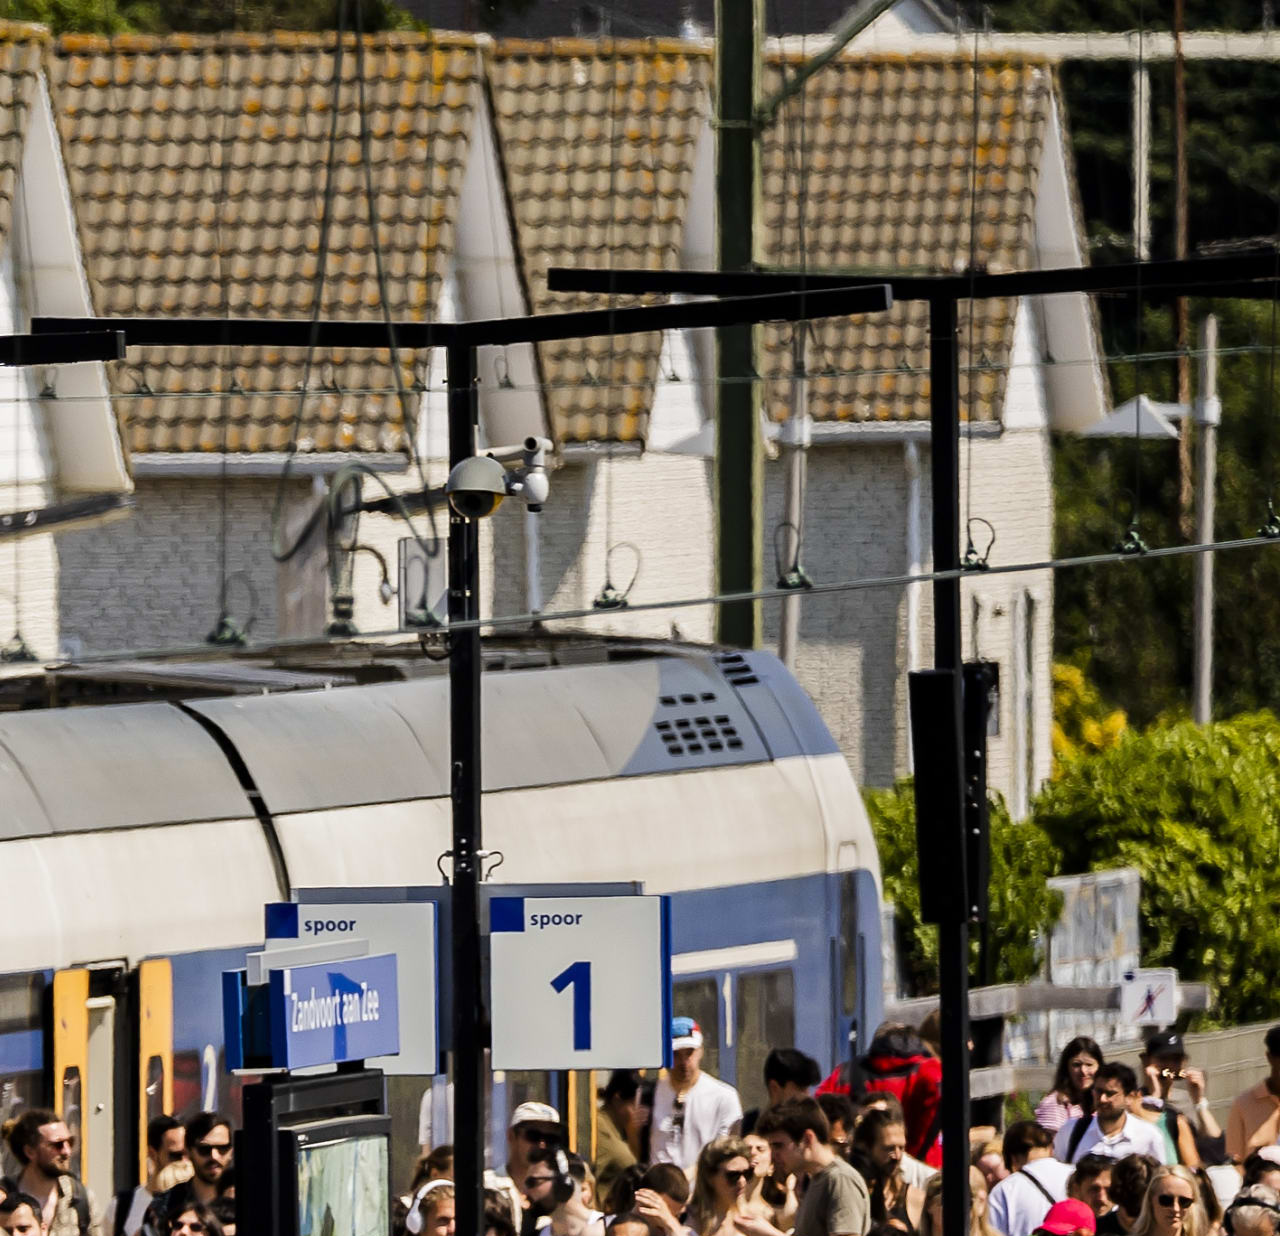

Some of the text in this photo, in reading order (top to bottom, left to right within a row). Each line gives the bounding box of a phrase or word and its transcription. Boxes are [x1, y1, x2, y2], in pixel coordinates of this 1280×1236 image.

[304, 920, 356, 935] spoor
[530, 914, 583, 929] spoor
[291, 981, 380, 1032] Zandvoort aan Zee
[550, 962, 591, 1051] 1
